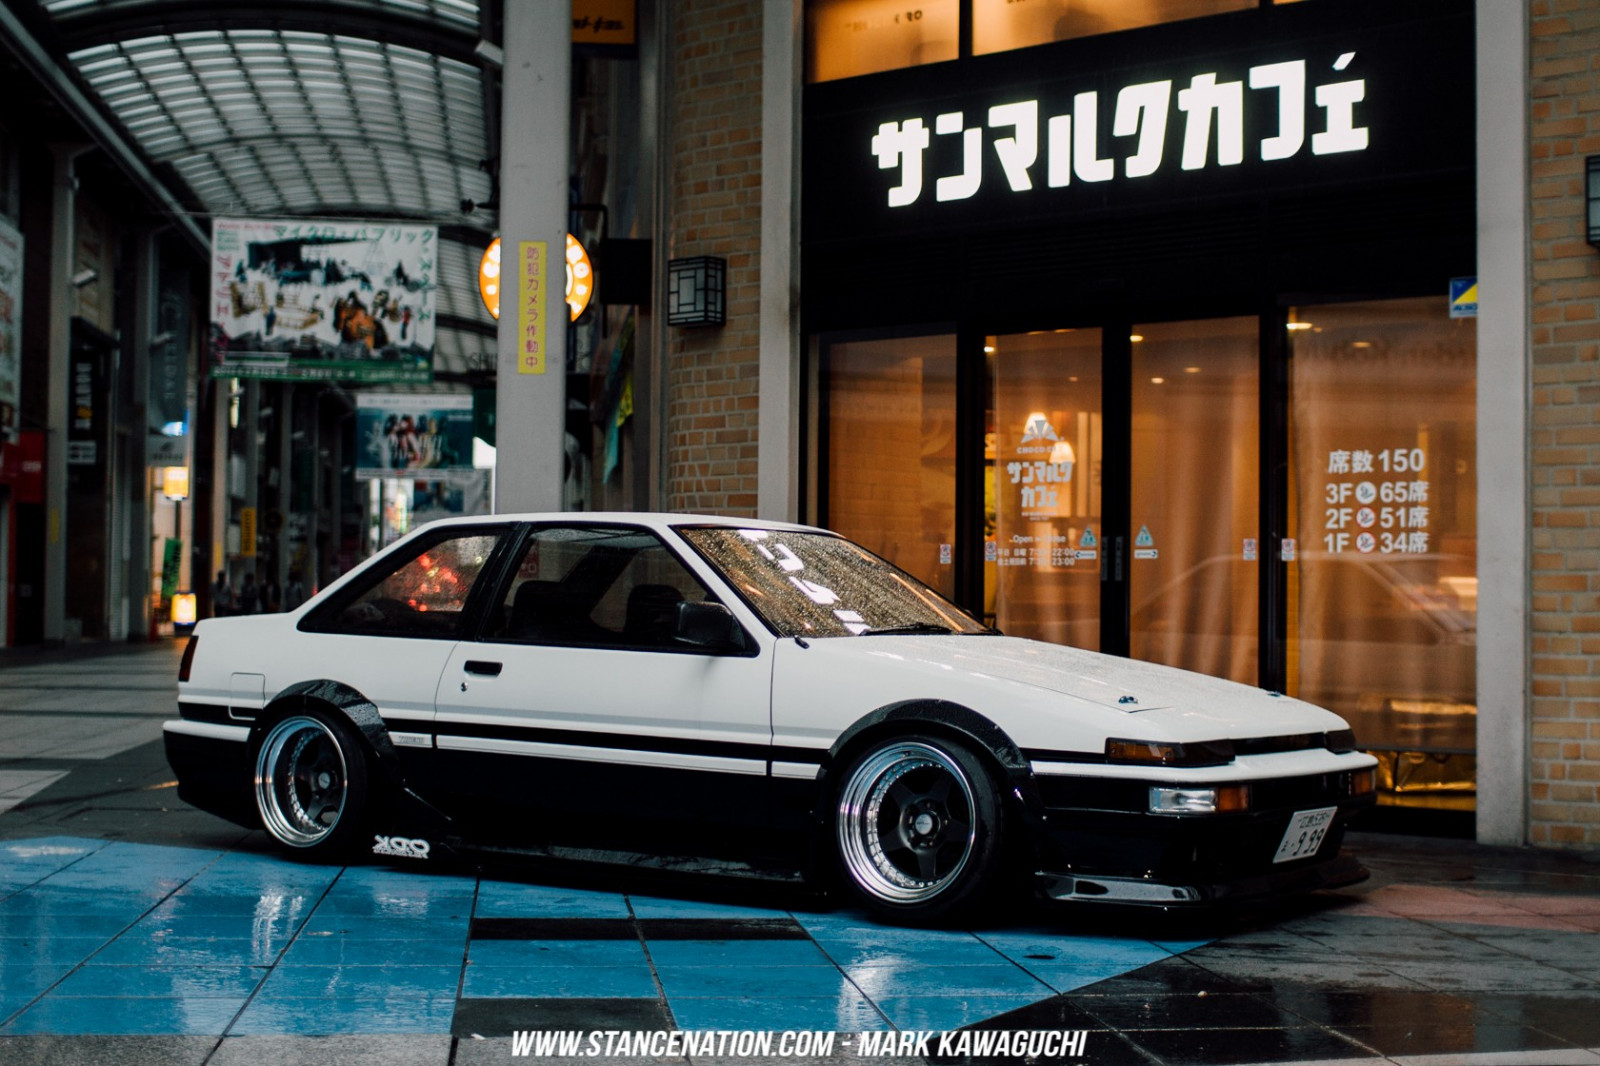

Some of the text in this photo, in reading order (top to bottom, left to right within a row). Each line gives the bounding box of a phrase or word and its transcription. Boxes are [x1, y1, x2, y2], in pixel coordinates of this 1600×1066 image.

[871, 51, 1370, 207] サンマルクカフェ
[525, 246, 540, 368] 防犯カメラ作動中
[1007, 461, 1073, 484] サンマルク
[1328, 448, 1425, 474] 席数 150
[1021, 485, 1059, 508] カフェ
[1325, 481, 1430, 505] 3F 65席
[1325, 506, 1430, 530] 2F 51席
[1323, 531, 1430, 555] 1F 34席
